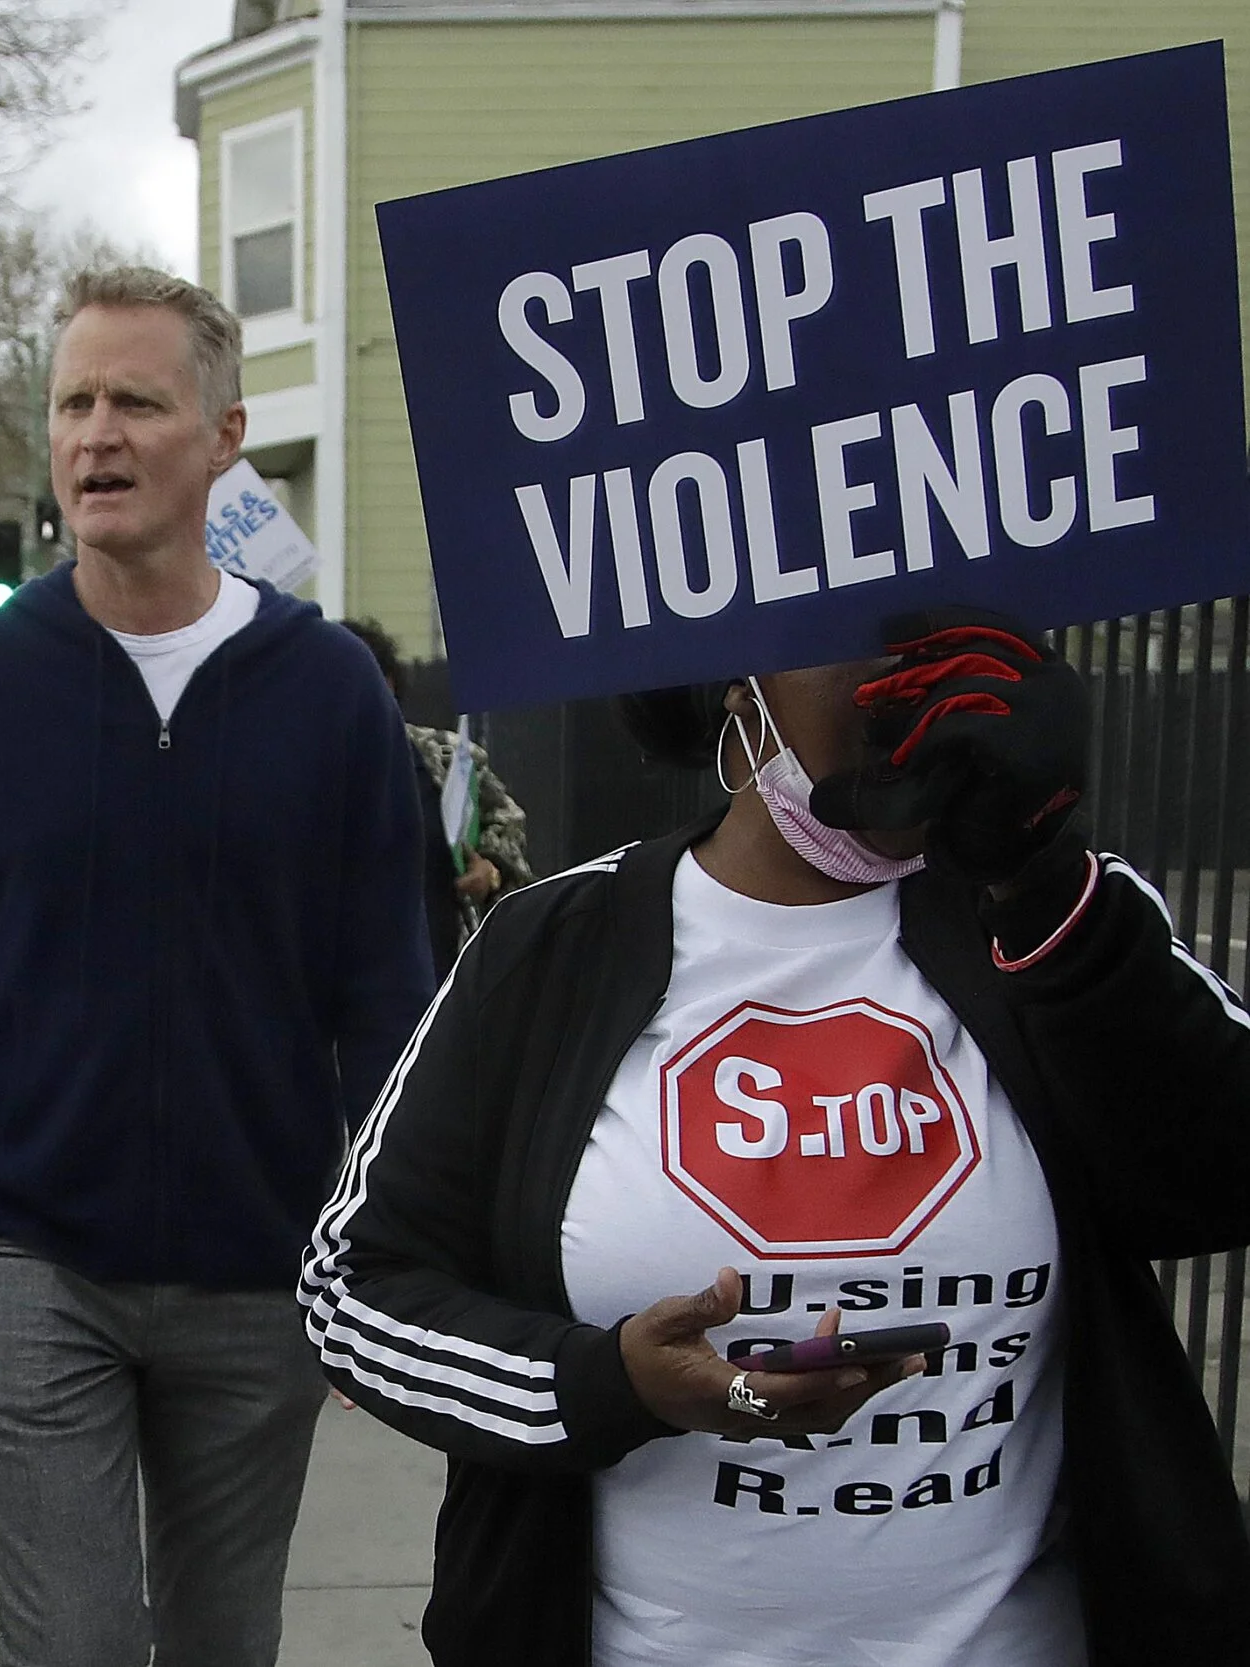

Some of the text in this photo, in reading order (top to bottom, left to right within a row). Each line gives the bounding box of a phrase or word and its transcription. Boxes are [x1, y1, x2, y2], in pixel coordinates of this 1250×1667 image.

[497, 139, 1134, 443] STOP THE
[514, 355, 1155, 641] VIOLENCE
[713, 1446, 1002, 1517] R.ead
